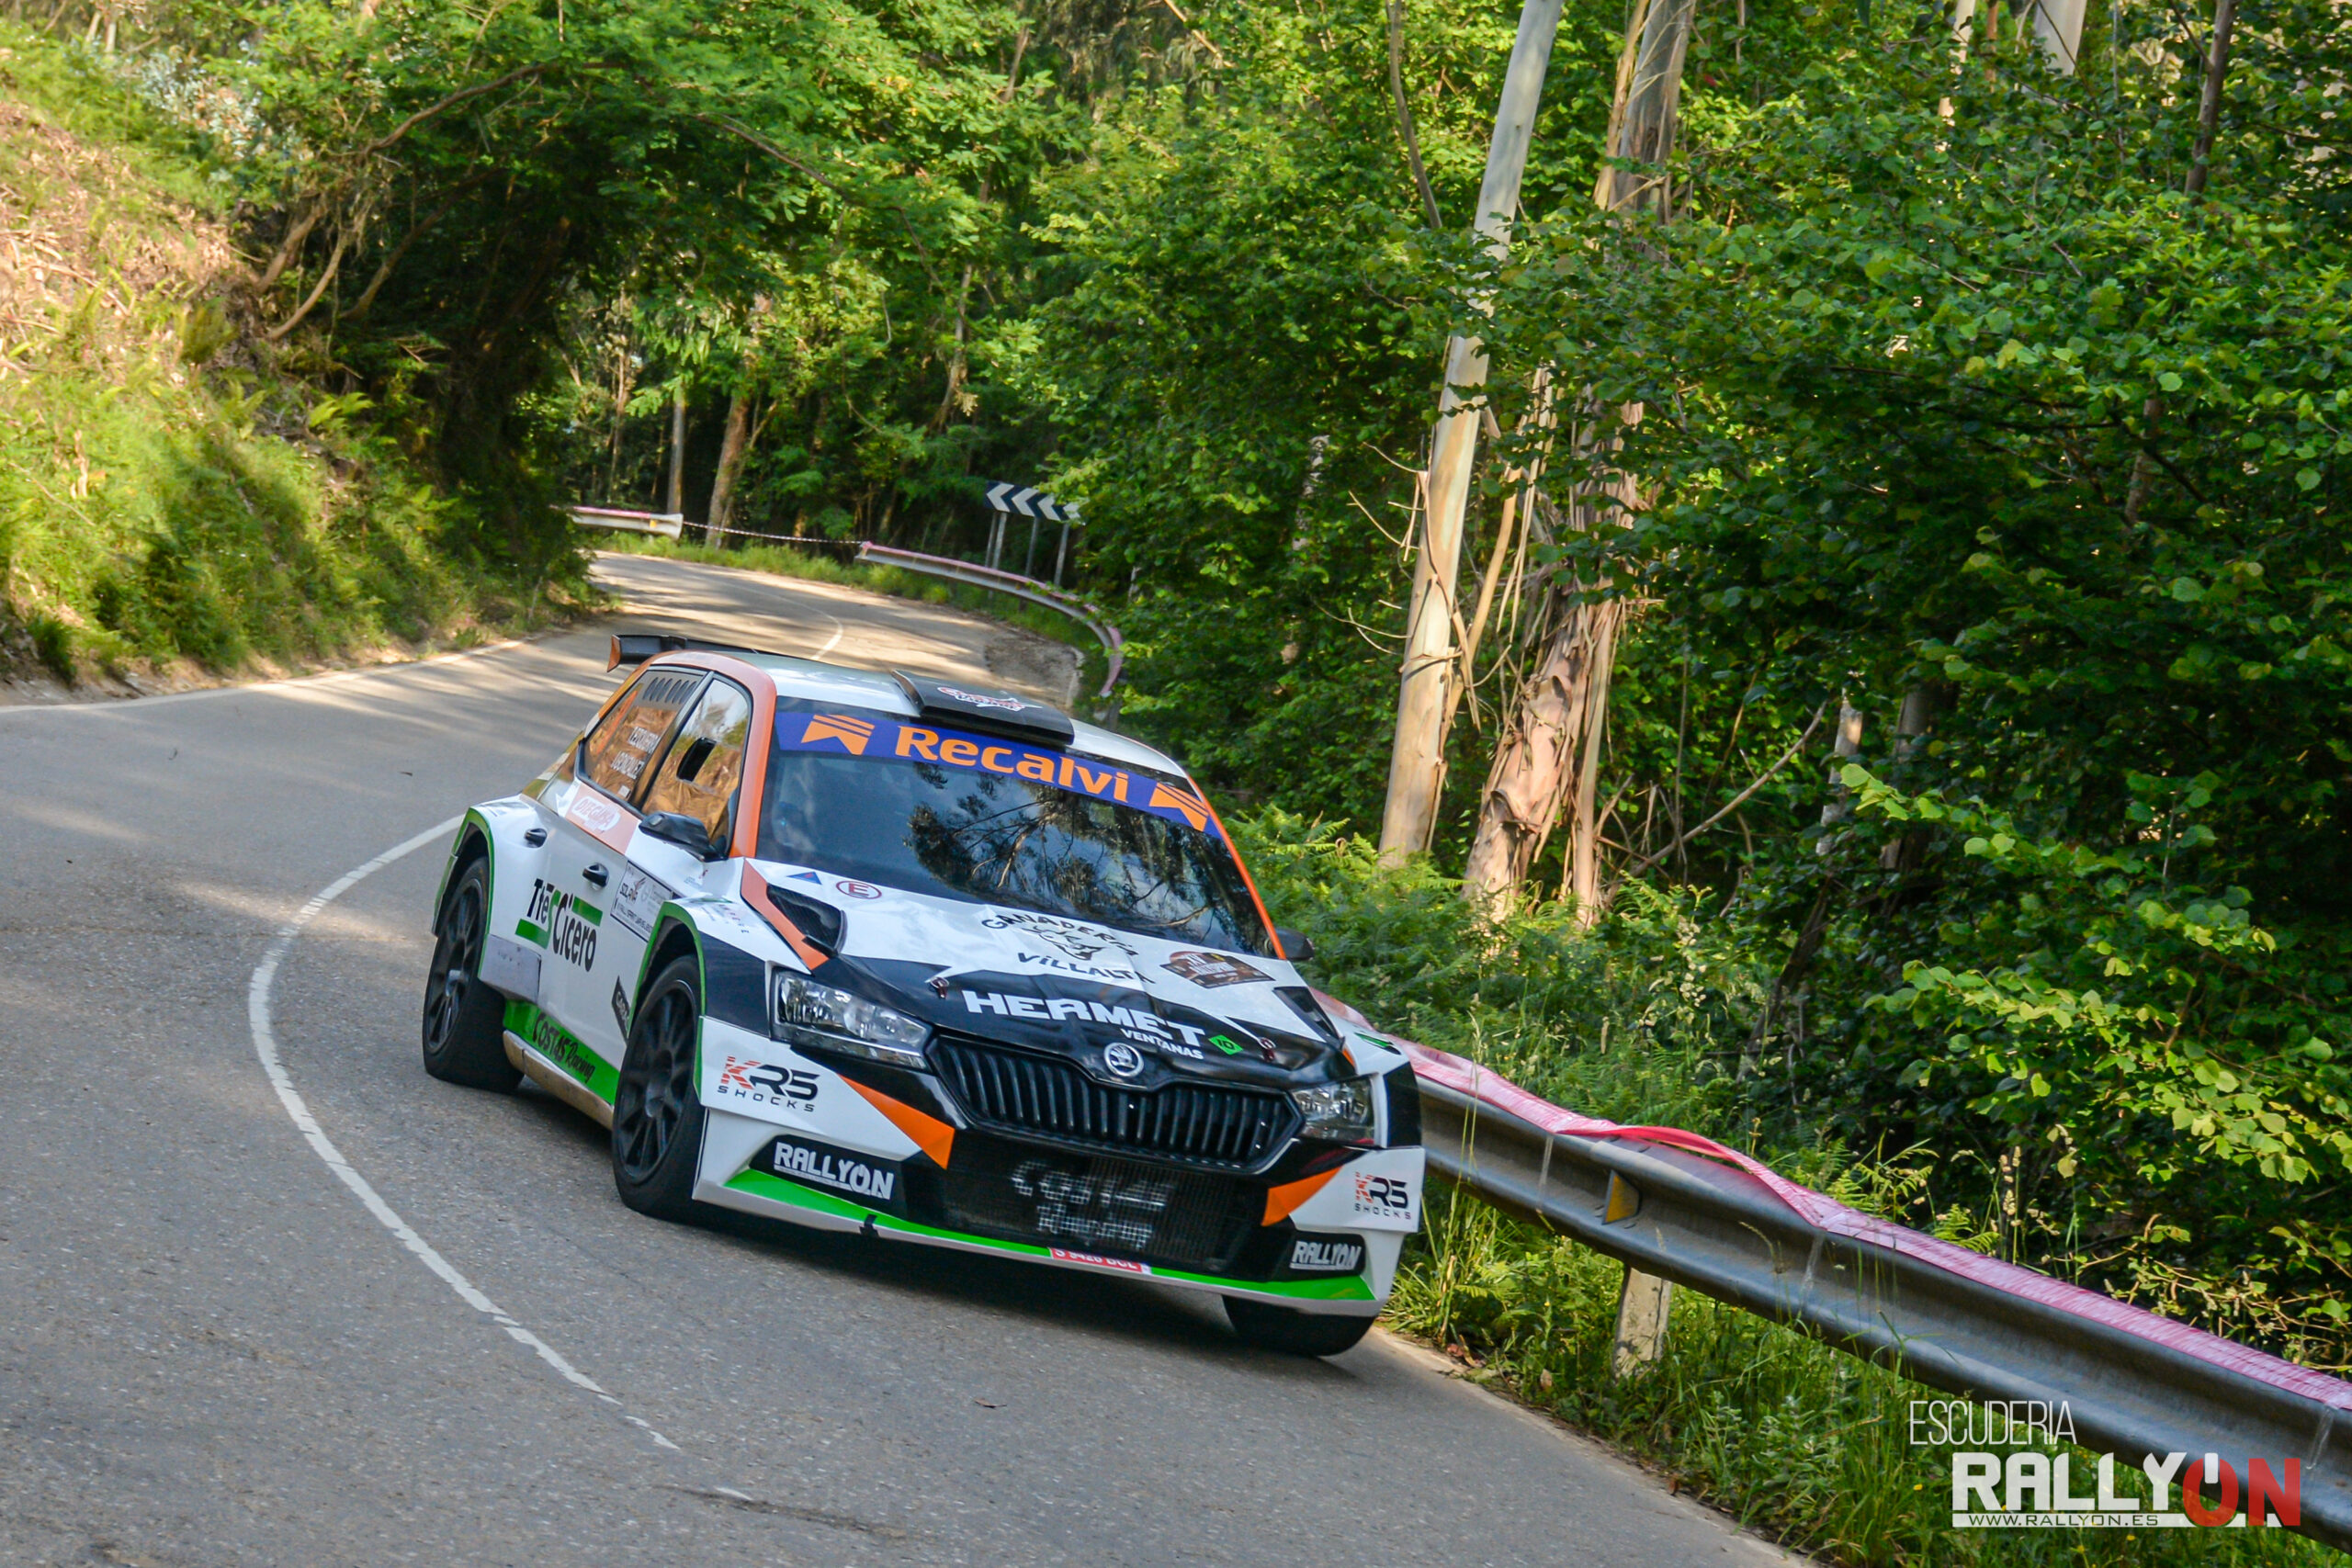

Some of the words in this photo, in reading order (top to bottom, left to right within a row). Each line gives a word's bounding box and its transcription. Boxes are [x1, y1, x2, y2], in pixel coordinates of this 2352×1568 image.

[895, 726, 1129, 803] Recalvi
[961, 990, 1205, 1048] HERMET
[565, 1041, 596, 1084] Racing
[1119, 1027, 1204, 1060] VENTANAS
[717, 1085, 816, 1113] SHOCKS
[774, 1142, 895, 1201] RALLYON
[1354, 1202, 1412, 1220] SHOCKS
[1289, 1240, 1363, 1271] RALLYON
